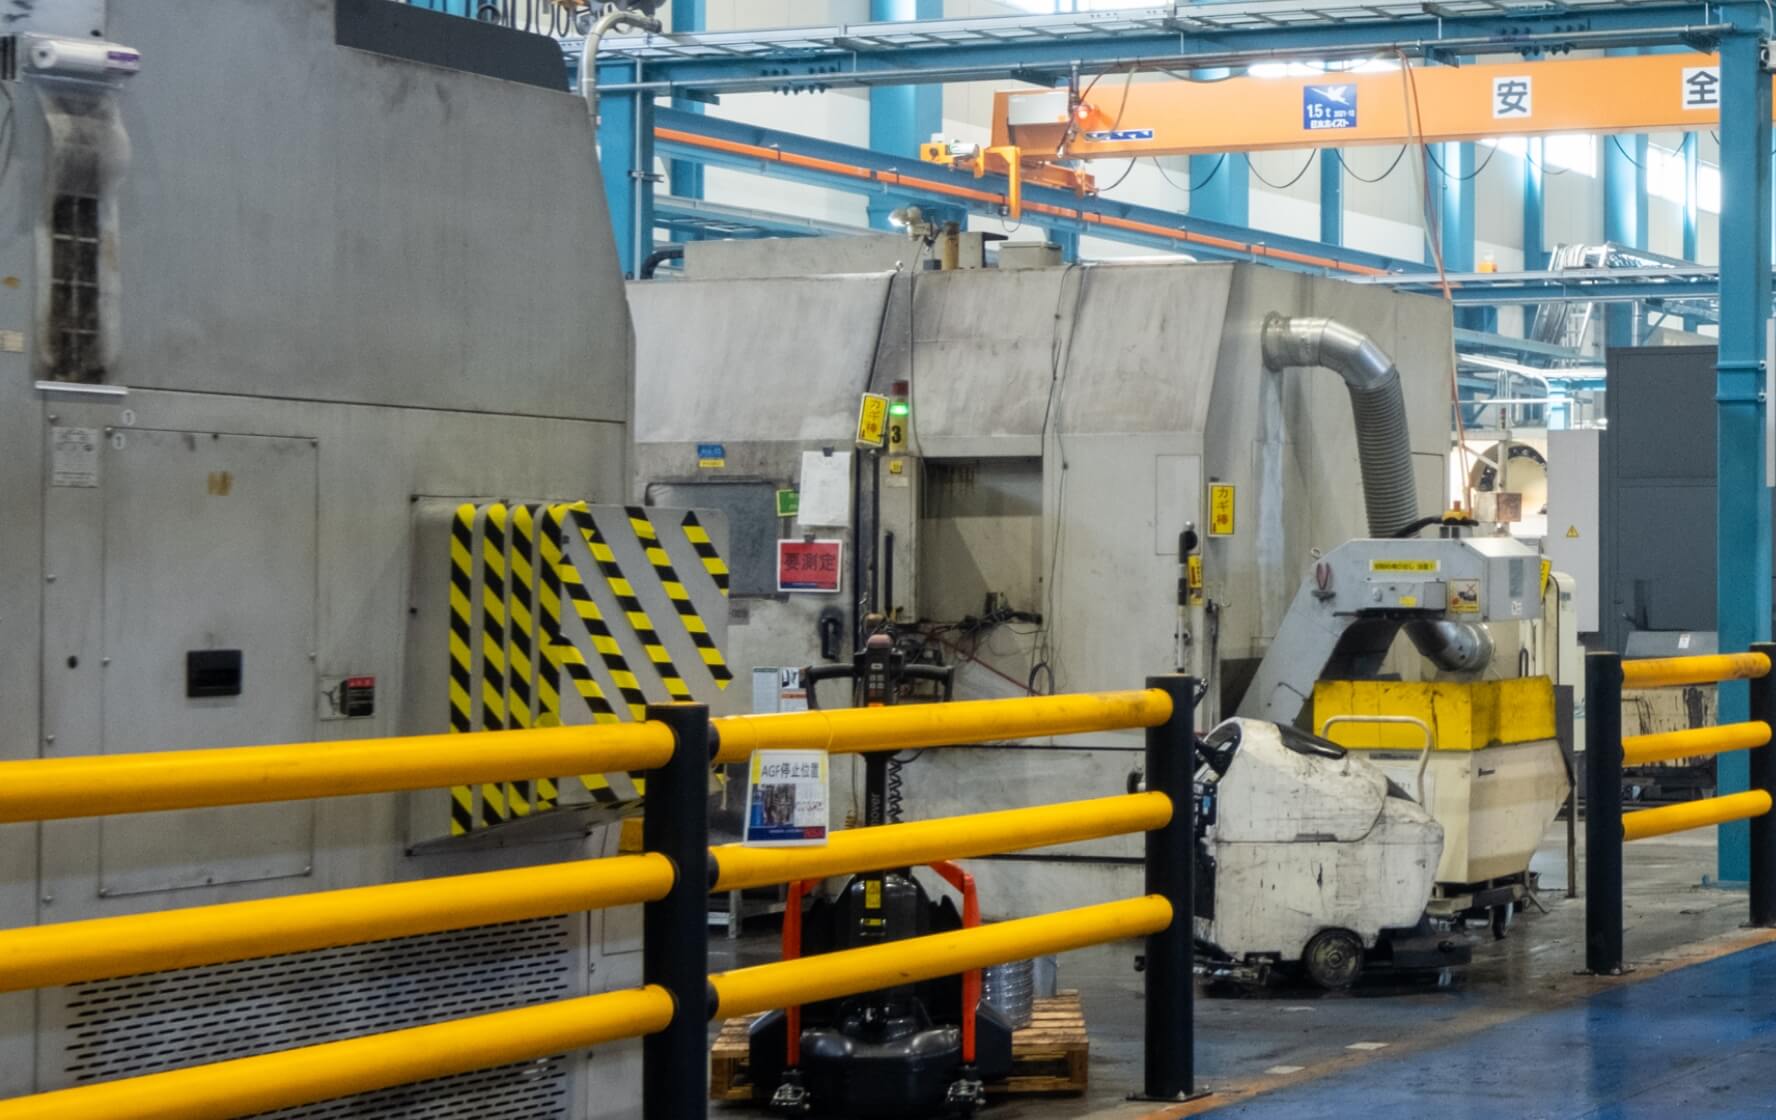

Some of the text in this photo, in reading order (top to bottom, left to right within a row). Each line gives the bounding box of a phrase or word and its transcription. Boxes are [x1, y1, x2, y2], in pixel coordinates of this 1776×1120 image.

[1497, 80, 1528, 114] 安
[1686, 71, 1718, 104] 全
[891, 425, 902, 444] 3
[783, 552, 836, 572] 要測定
